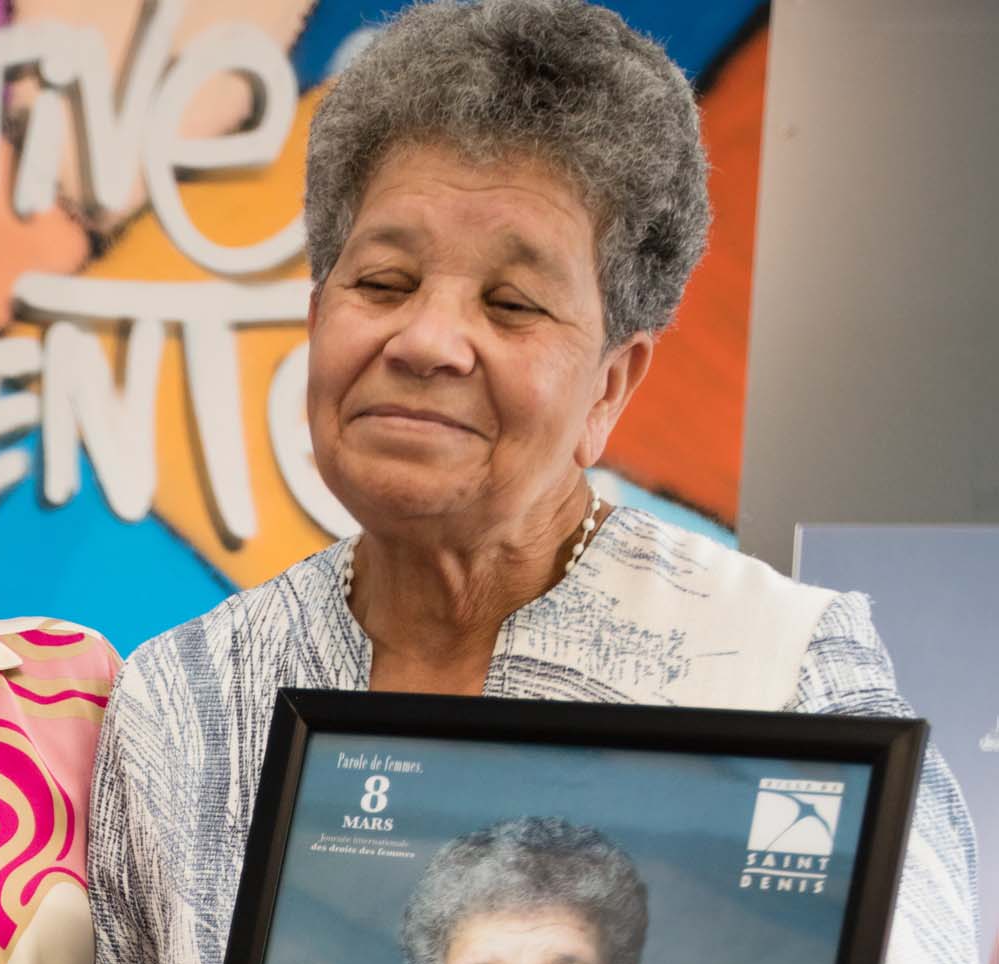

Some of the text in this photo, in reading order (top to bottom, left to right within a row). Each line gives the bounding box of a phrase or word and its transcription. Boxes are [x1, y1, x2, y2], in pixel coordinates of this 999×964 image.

[336, 751, 368, 769] Parole
[370, 753, 382, 770] de
[360, 774, 390, 813] 8
[341, 815, 394, 832] MARS
[310, 842, 327, 852] des
[328, 843, 357, 854] droits
[359, 846, 376, 856] des
[746, 852, 830, 871] SAINT
[739, 874, 825, 894] DENIS
